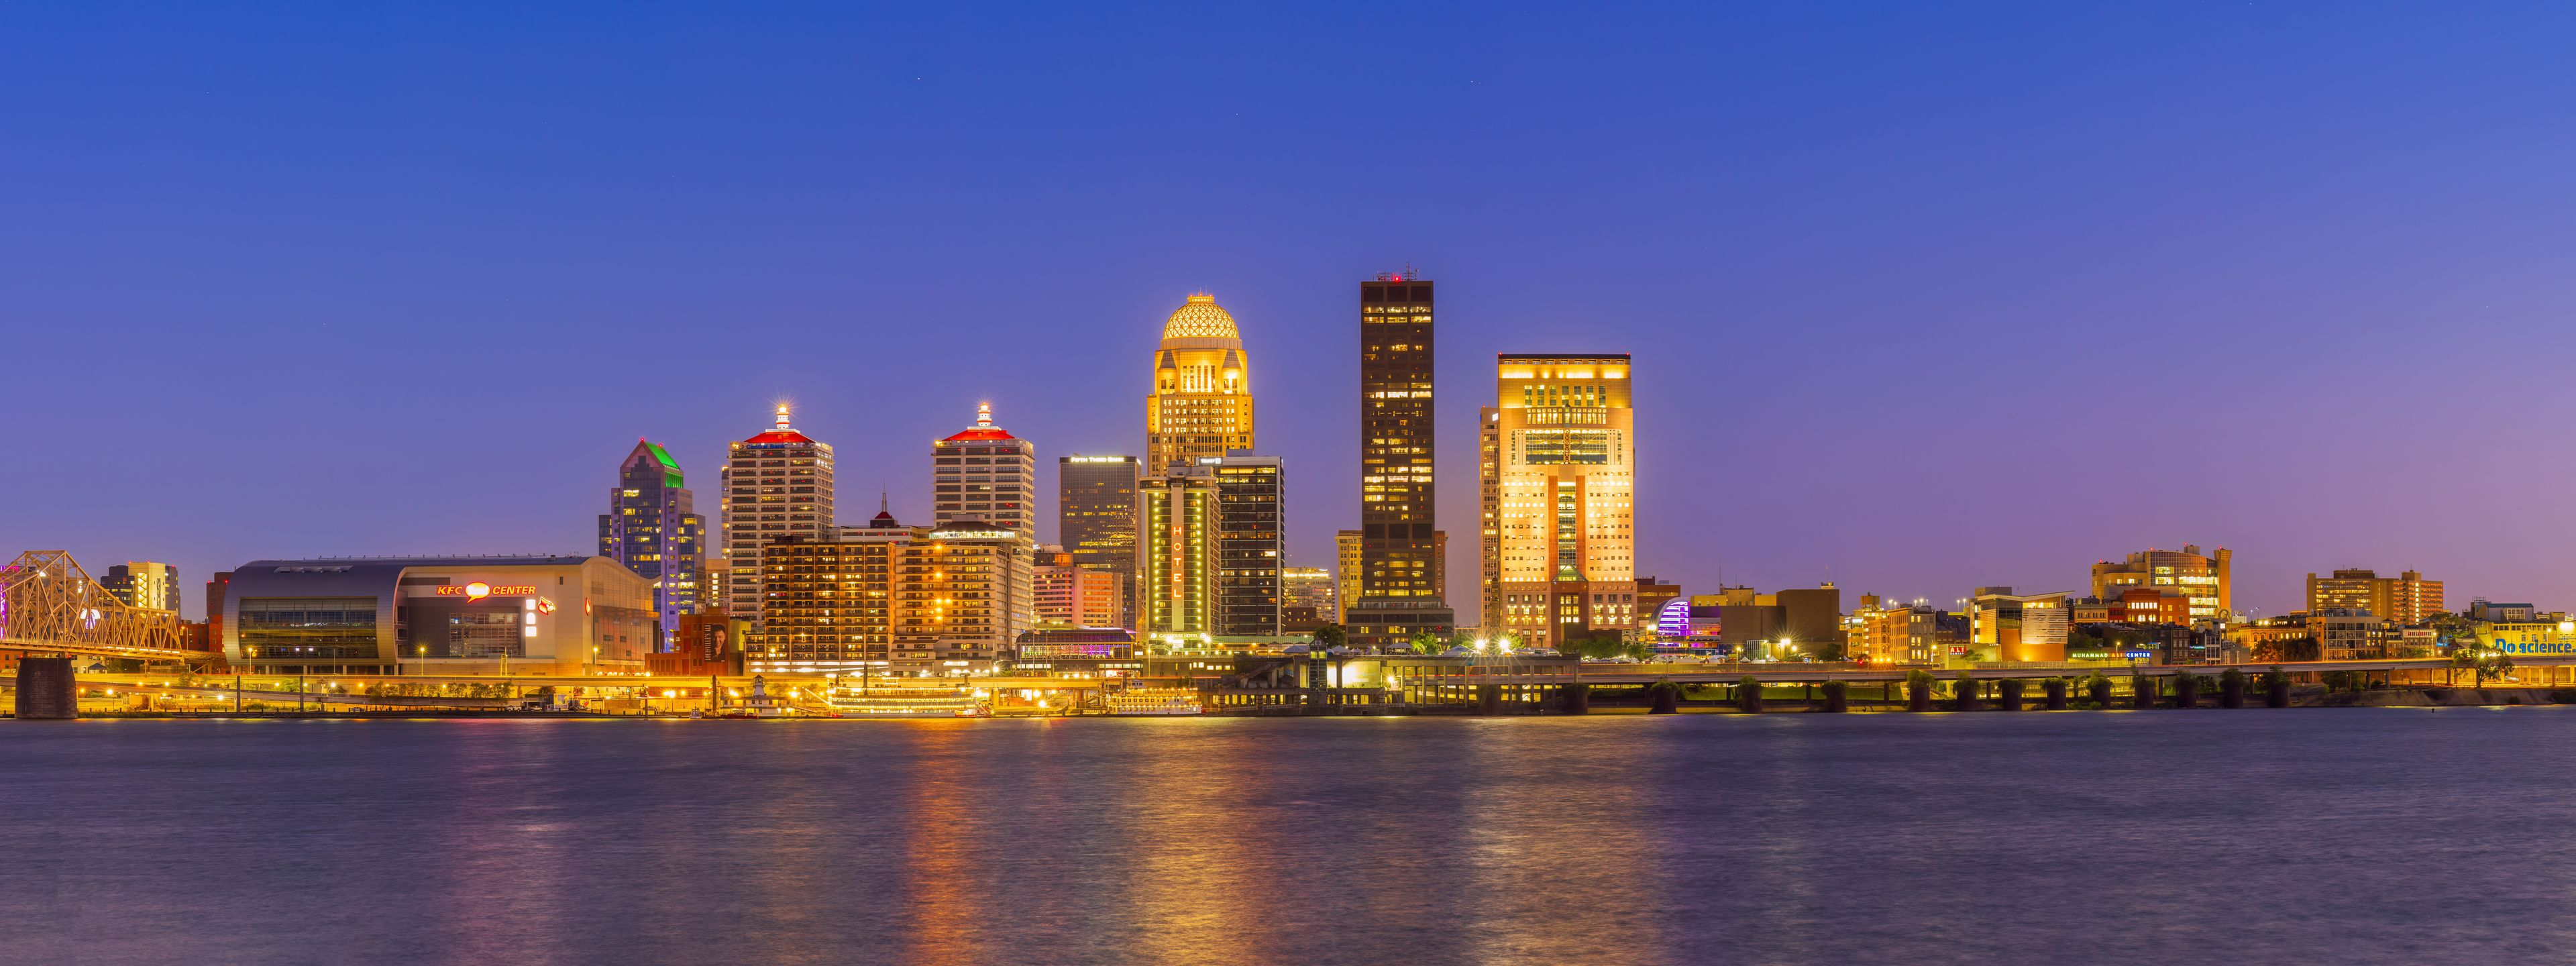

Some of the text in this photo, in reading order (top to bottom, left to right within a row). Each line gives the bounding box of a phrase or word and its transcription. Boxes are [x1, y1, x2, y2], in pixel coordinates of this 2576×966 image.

[1173, 527, 1181, 598] HOTEL
[437, 586, 463, 595] KFC
[492, 586, 536, 595] CENTER
[2495, 638, 2516, 653] Do
